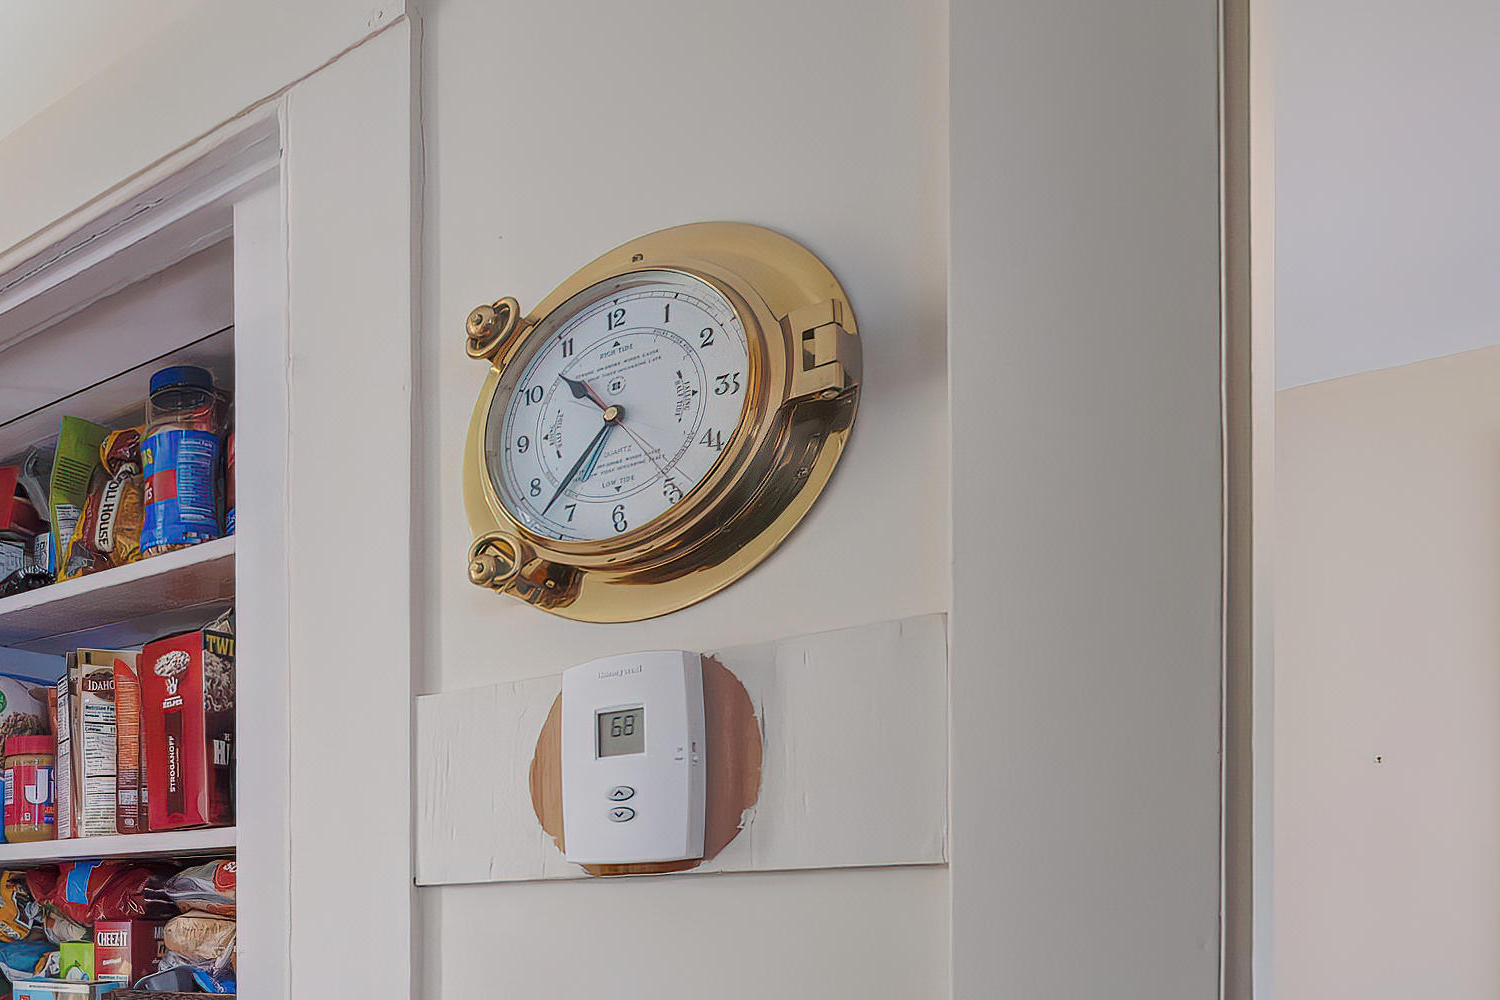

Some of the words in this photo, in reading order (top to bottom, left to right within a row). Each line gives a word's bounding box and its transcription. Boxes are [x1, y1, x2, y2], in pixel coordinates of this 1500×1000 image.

[607, 309, 626, 331] 12
[664, 304, 670, 323] 1
[561, 338, 574, 358] 11
[700, 327, 714, 349] 2
[524, 385, 543, 406] 10
[517, 435, 529, 454] 9
[530, 478, 541, 497] 8
[565, 503, 577, 522] 7
[87, 680, 115, 691] IDAHO
[611, 715, 635, 738] 68
[168, 735, 176, 793] STROGANOFF
